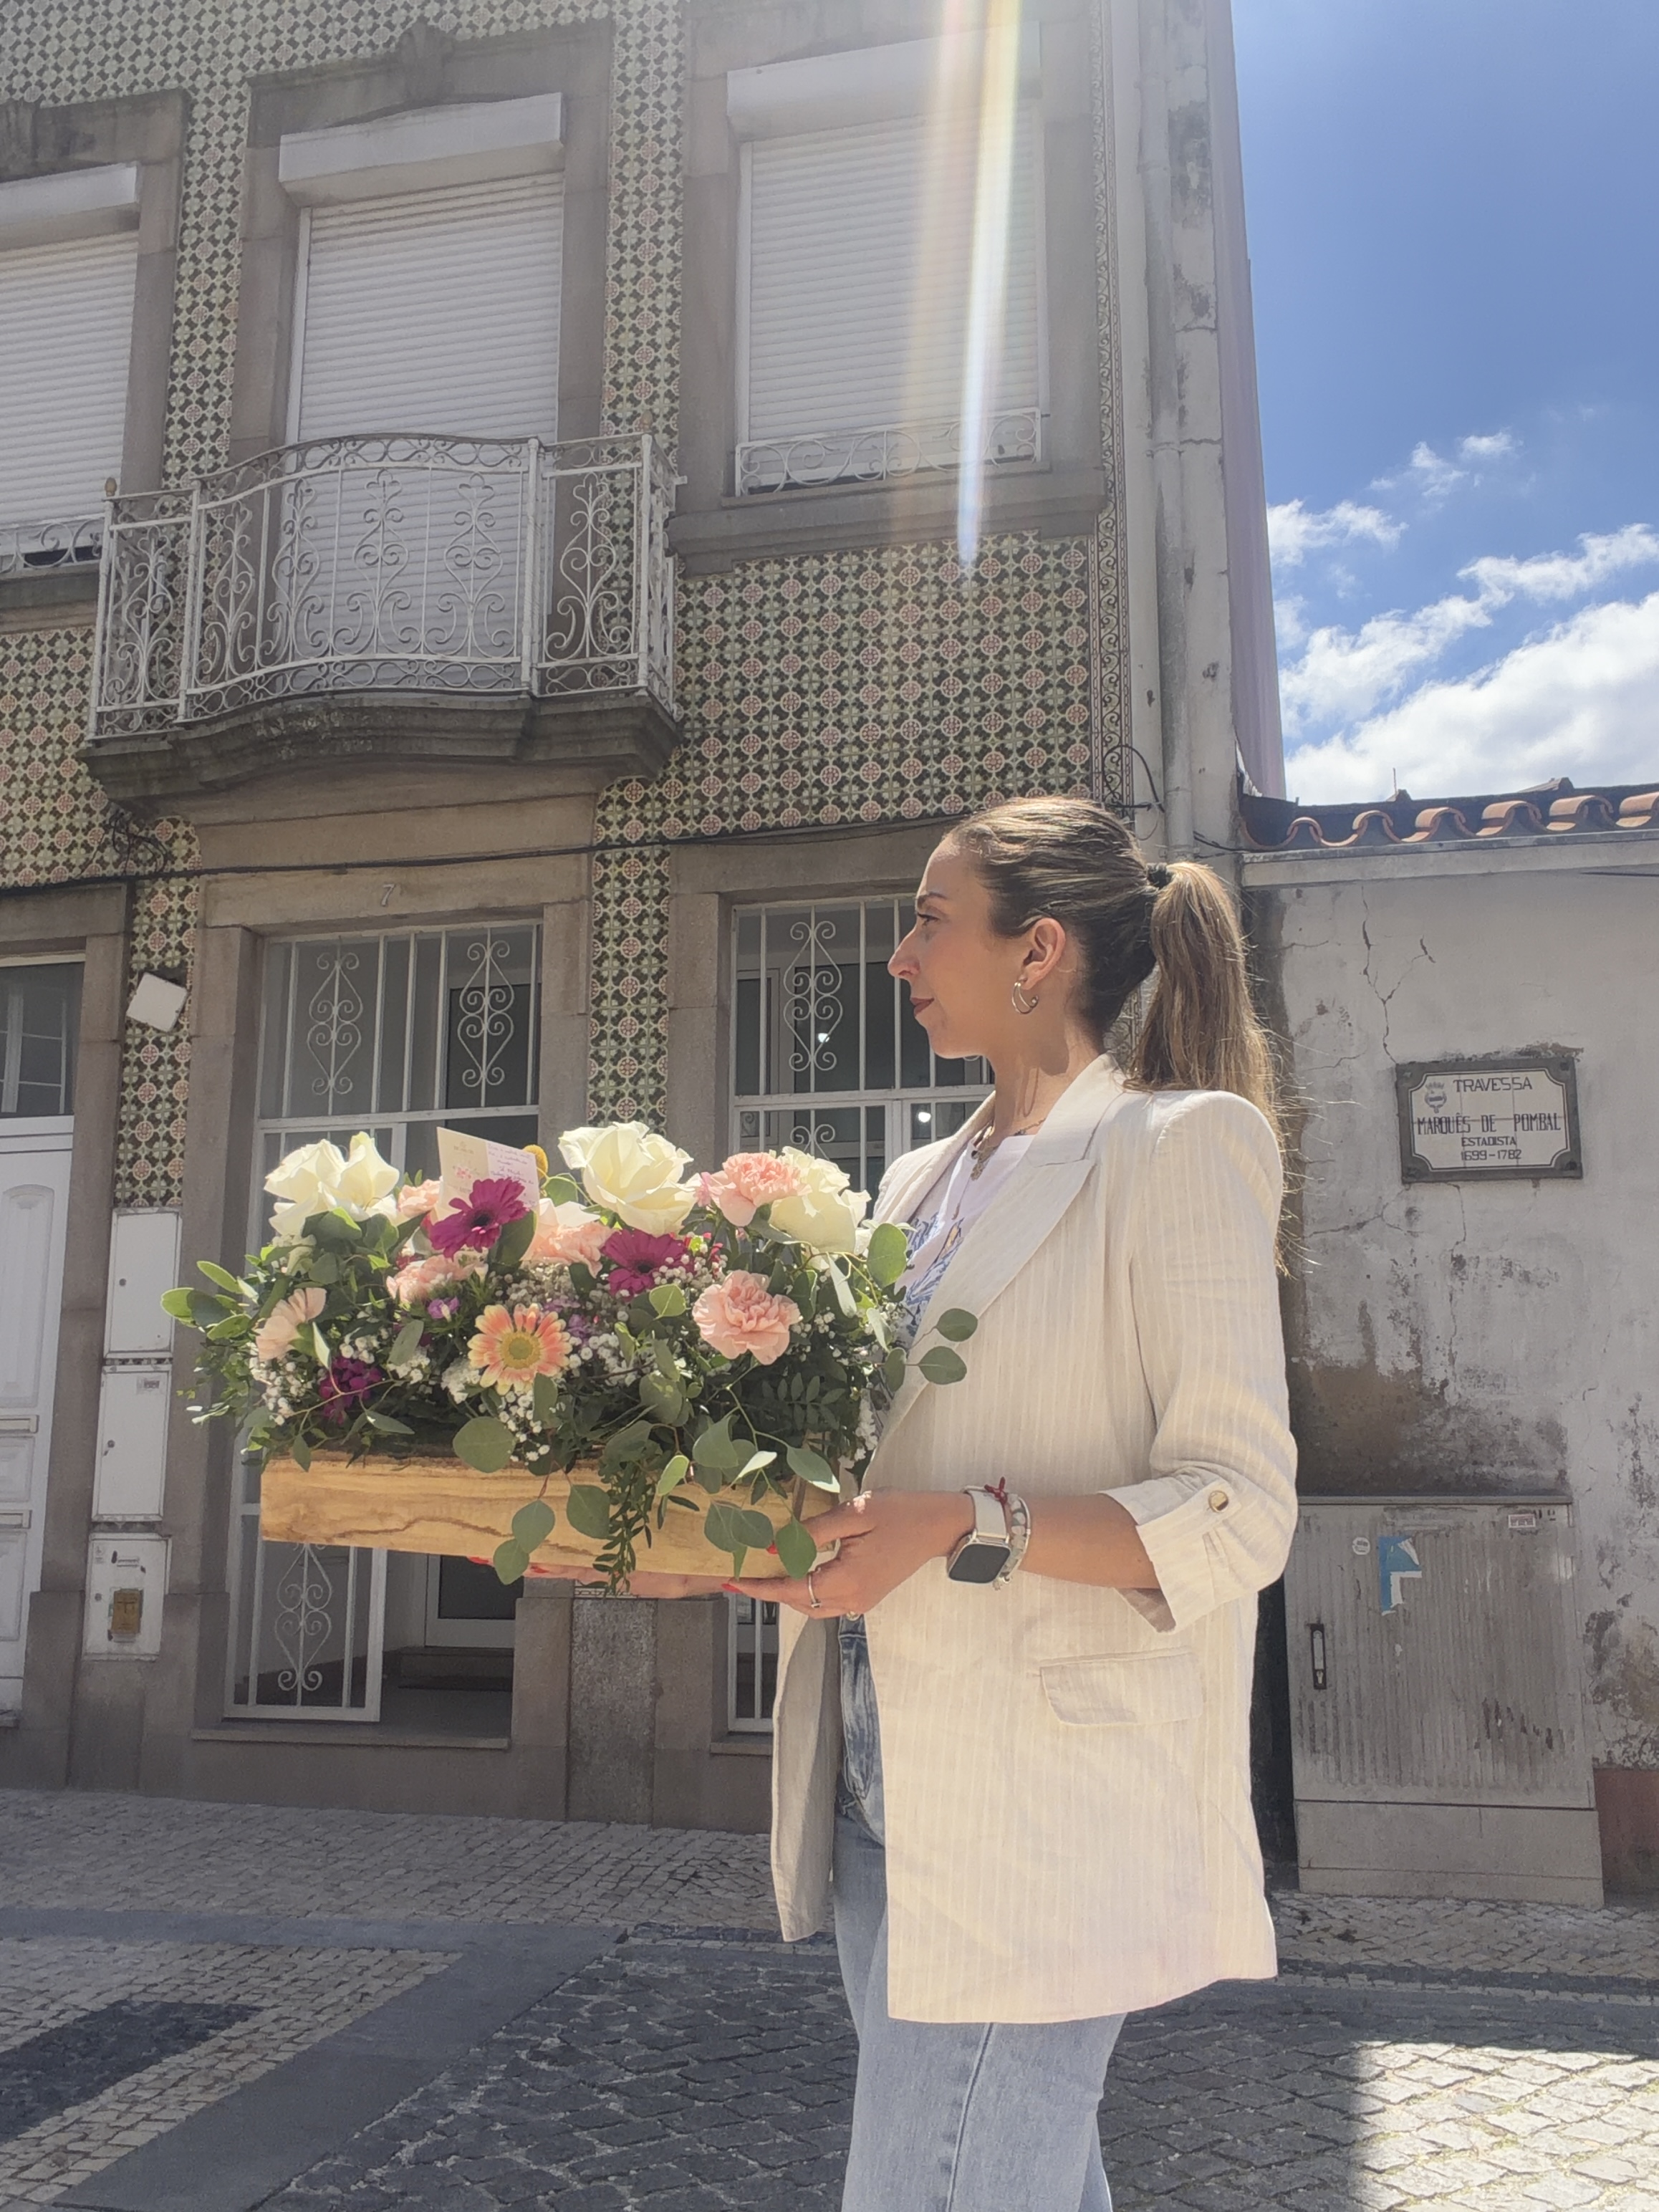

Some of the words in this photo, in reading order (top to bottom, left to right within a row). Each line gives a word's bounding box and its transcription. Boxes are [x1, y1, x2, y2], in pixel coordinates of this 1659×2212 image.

[382, 883, 395, 906] 7
[1453, 1077, 1532, 1092] TRAVESSA
[1417, 1112, 1471, 1135] MARQUÊS
[1481, 1115, 1497, 1133] DE
[1514, 1112, 1562, 1132] POMBAL
[1461, 1136, 1517, 1147] ESTADISTA
[1461, 1149, 1522, 1161] 1699-1782
